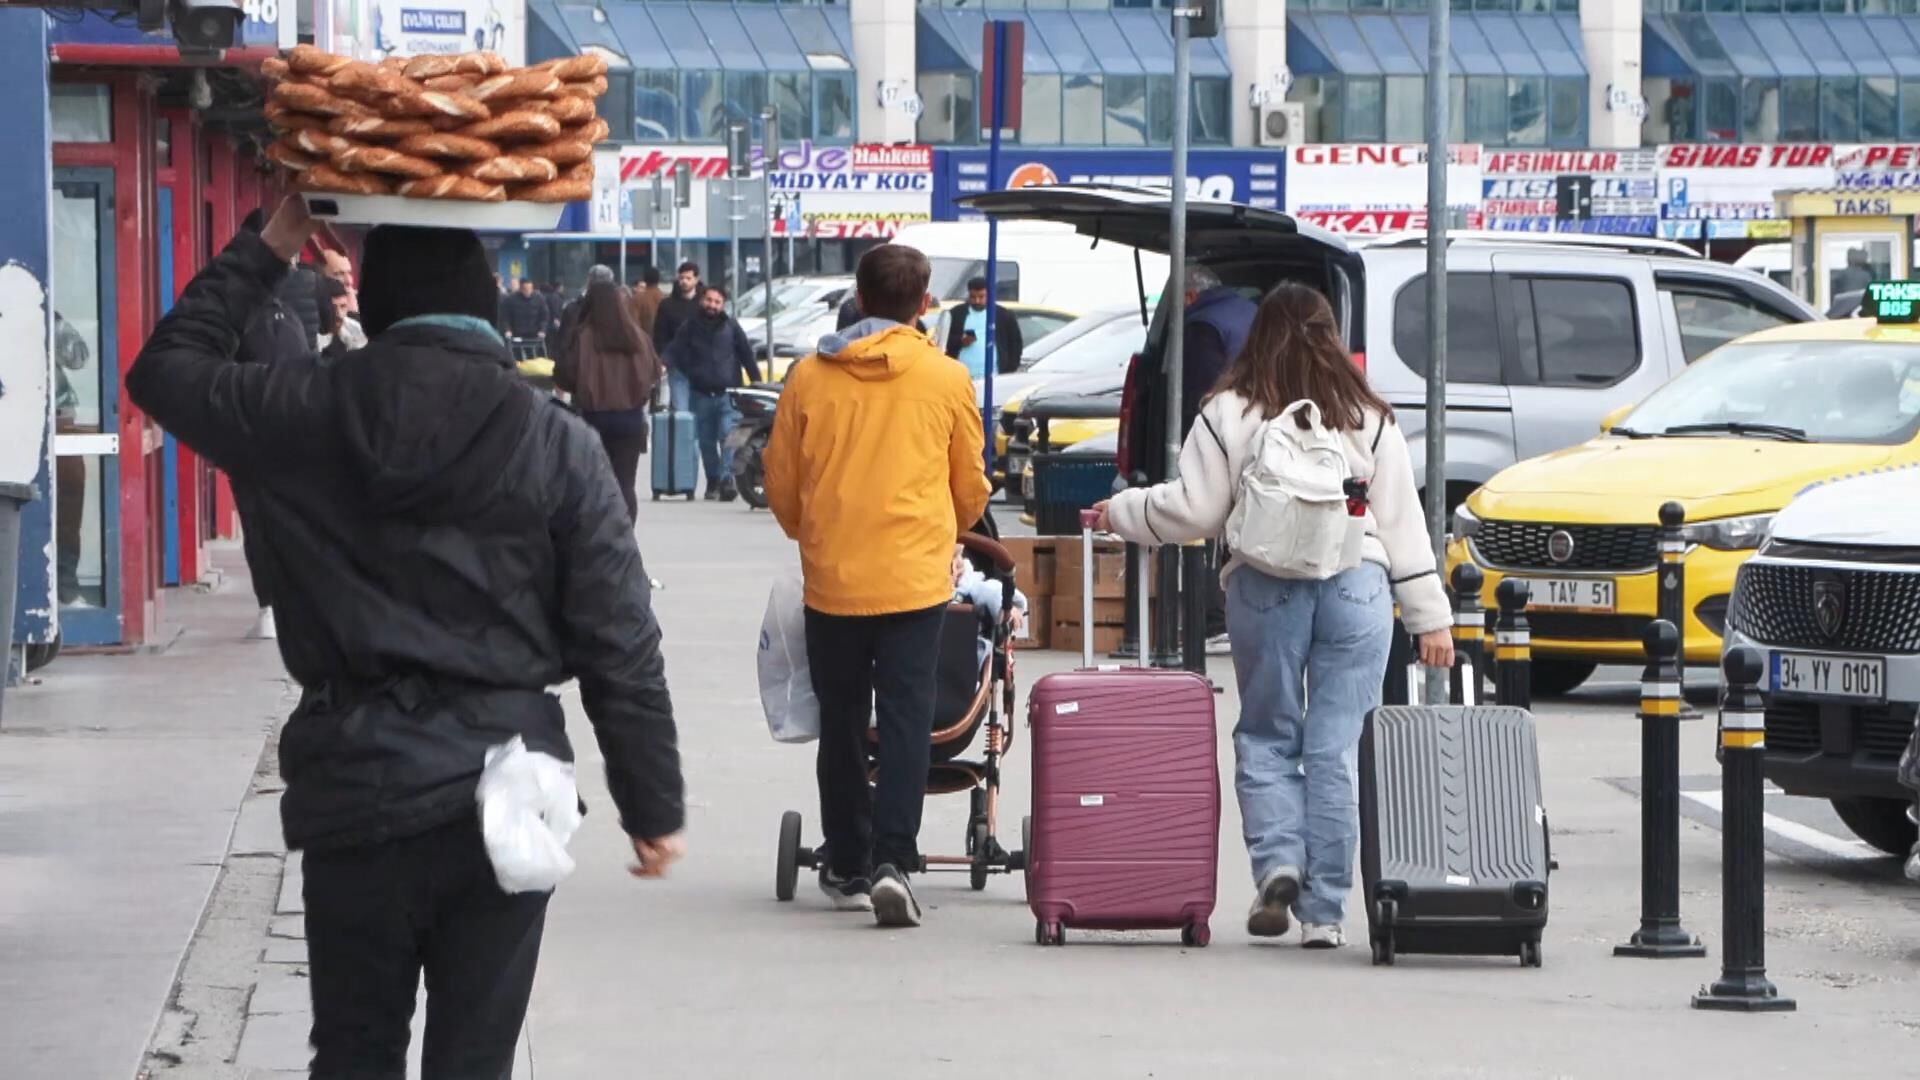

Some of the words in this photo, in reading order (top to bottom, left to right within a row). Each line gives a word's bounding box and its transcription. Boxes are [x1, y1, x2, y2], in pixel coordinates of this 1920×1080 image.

[1295, 146, 1415, 167] GENÇ
[1768, 145, 1833, 168] TUR
[1548, 581, 1577, 604] TAV
[1592, 583, 1610, 605] 51
[1781, 658, 1800, 688] 34
[1812, 660, 1831, 691] YY
[1842, 662, 1879, 694] 0101
